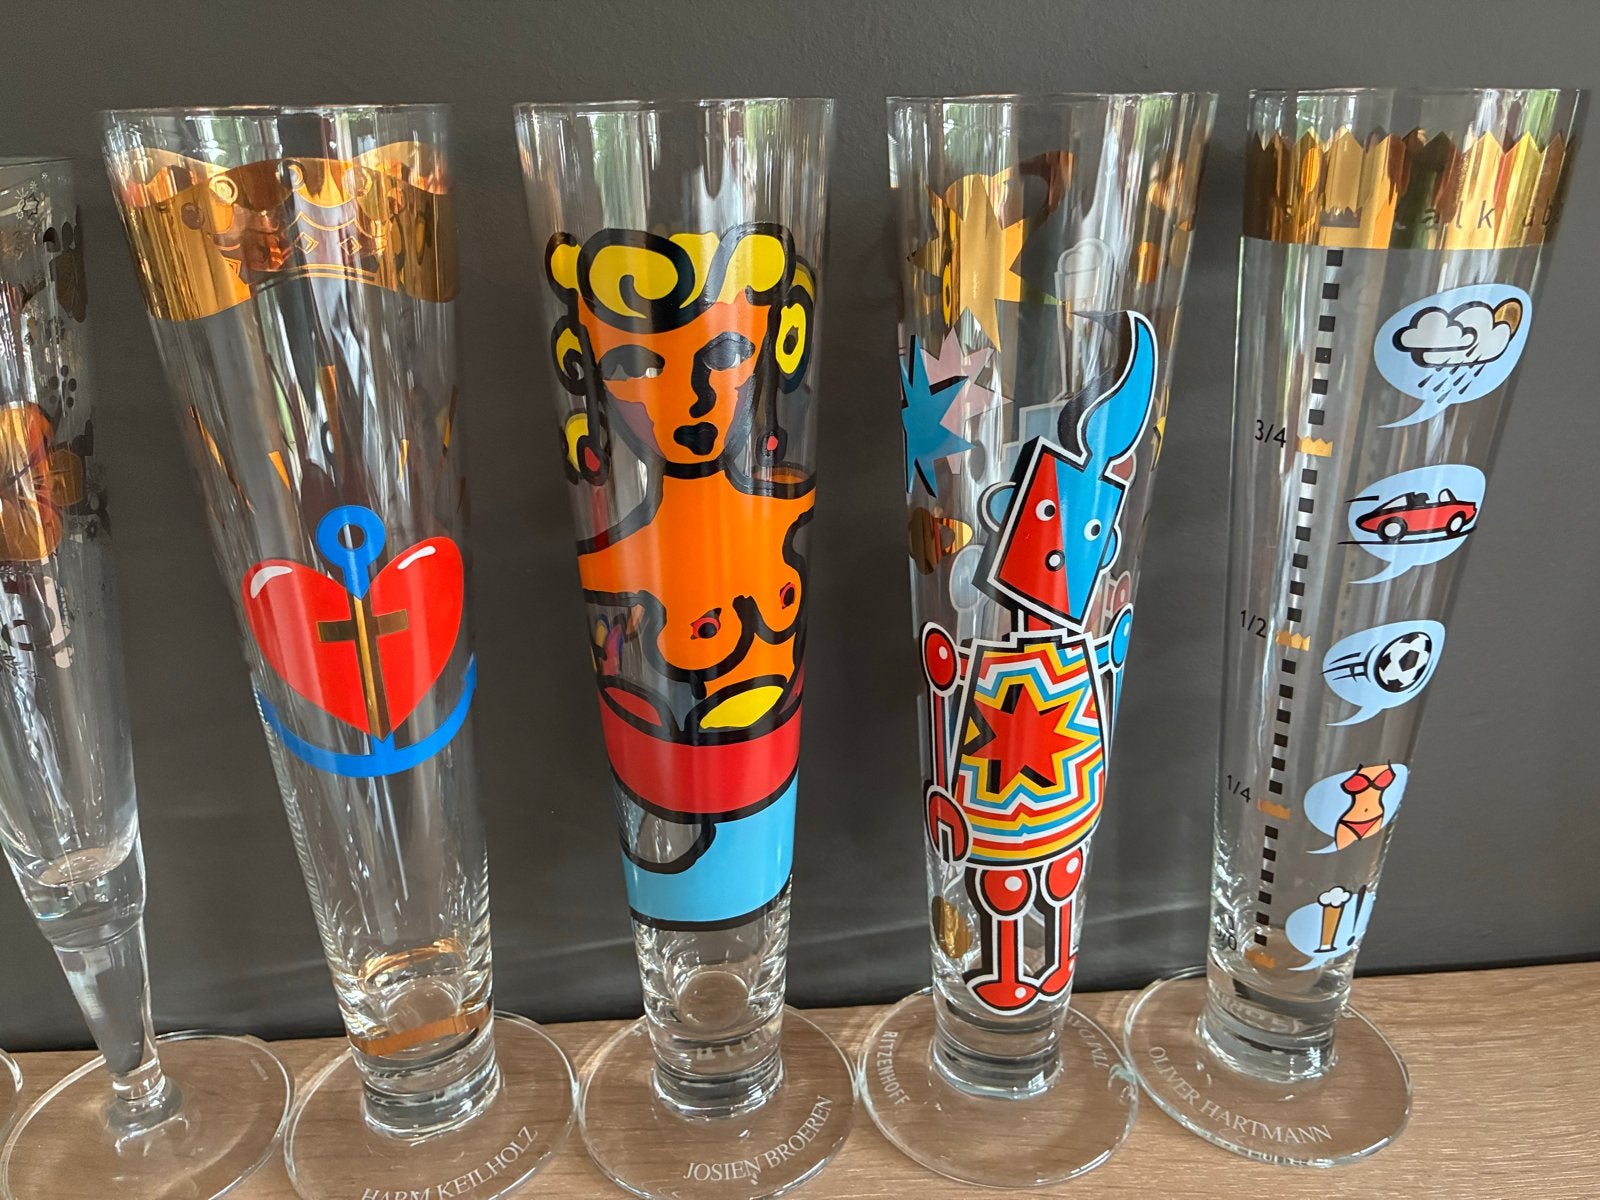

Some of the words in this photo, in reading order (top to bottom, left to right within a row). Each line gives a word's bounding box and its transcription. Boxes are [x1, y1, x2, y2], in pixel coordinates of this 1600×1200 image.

[1254, 418, 1287, 449] 3/4
[1239, 609, 1267, 639] 1/2
[1226, 773, 1252, 803] 1/4
[876, 1030, 911, 1105] RITZENHOFF
[1148, 1046, 1201, 1106] OLIVER
[1200, 1099, 1333, 1145] HARTMANN
[436, 1125, 539, 1200] KEILHOLZ
[682, 1156, 763, 1182] JOSIEN
[763, 1095, 834, 1169] BROEREN
